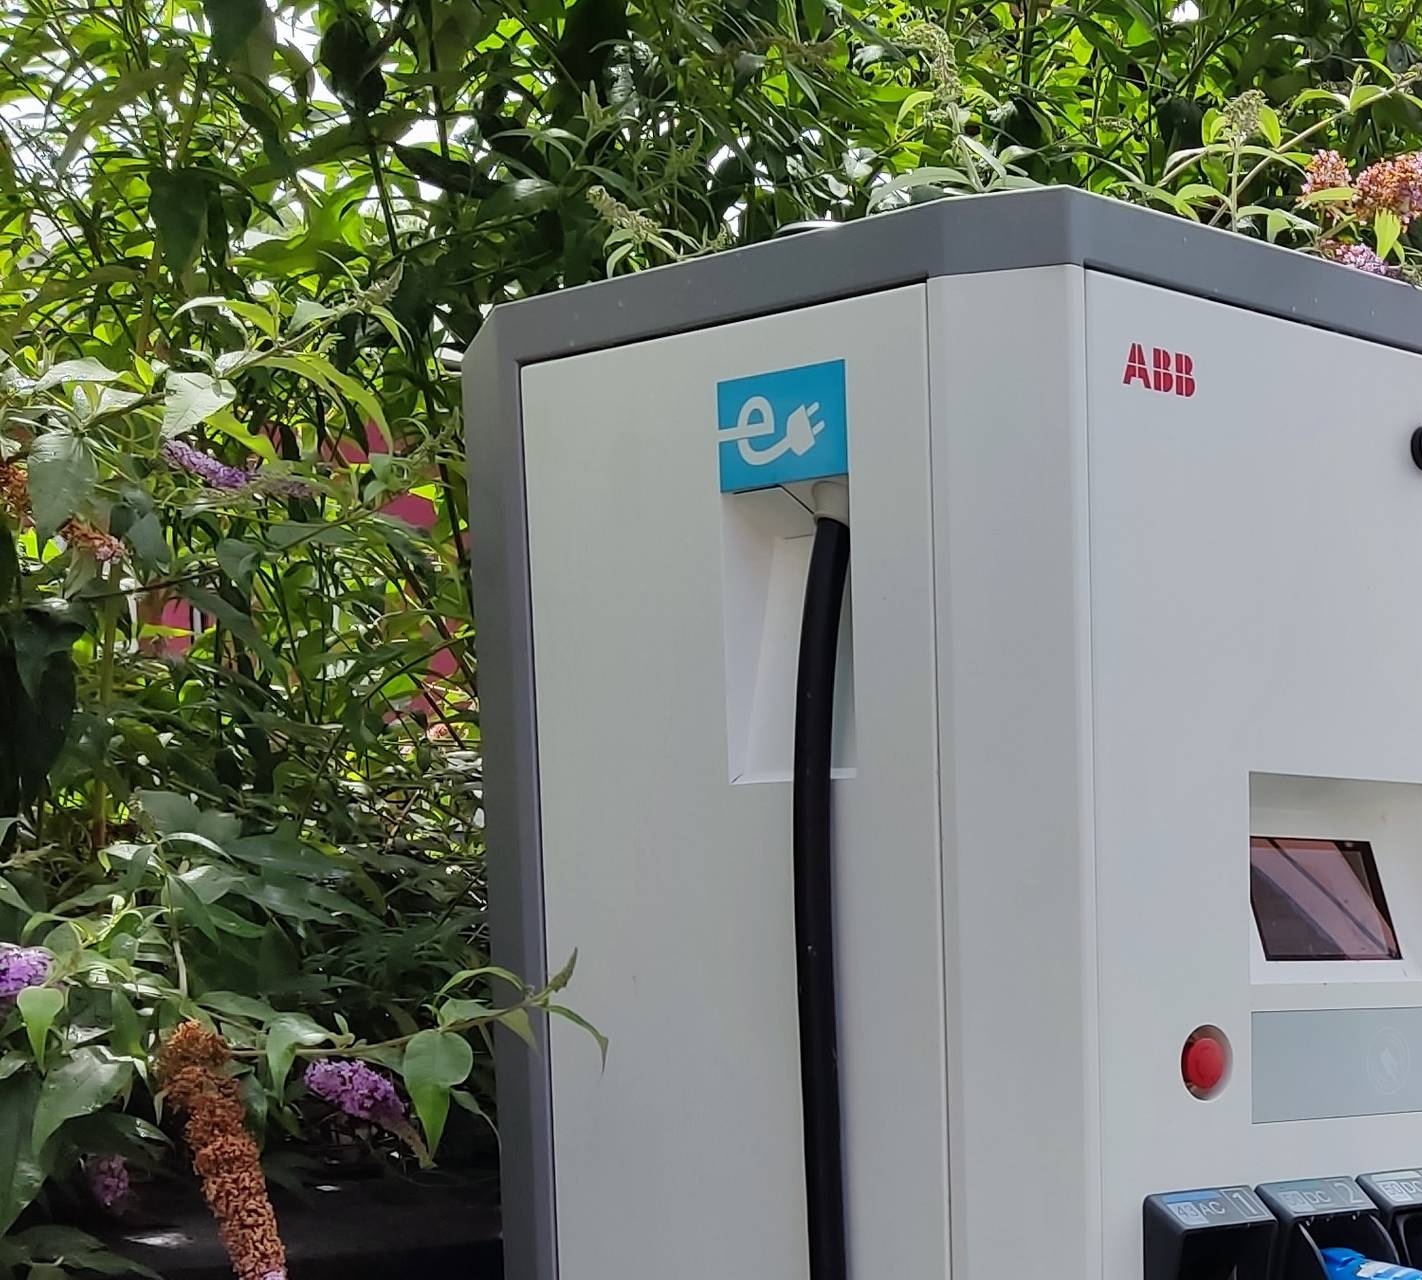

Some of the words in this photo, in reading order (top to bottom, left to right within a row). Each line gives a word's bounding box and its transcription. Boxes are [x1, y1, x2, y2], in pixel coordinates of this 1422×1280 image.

[1123, 342, 1196, 398] ABB
[1199, 1201, 1226, 1216] AC
[1231, 1192, 1258, 1215] 1
[1303, 1190, 1331, 1204] DC
[1334, 1182, 1364, 1204] 2
